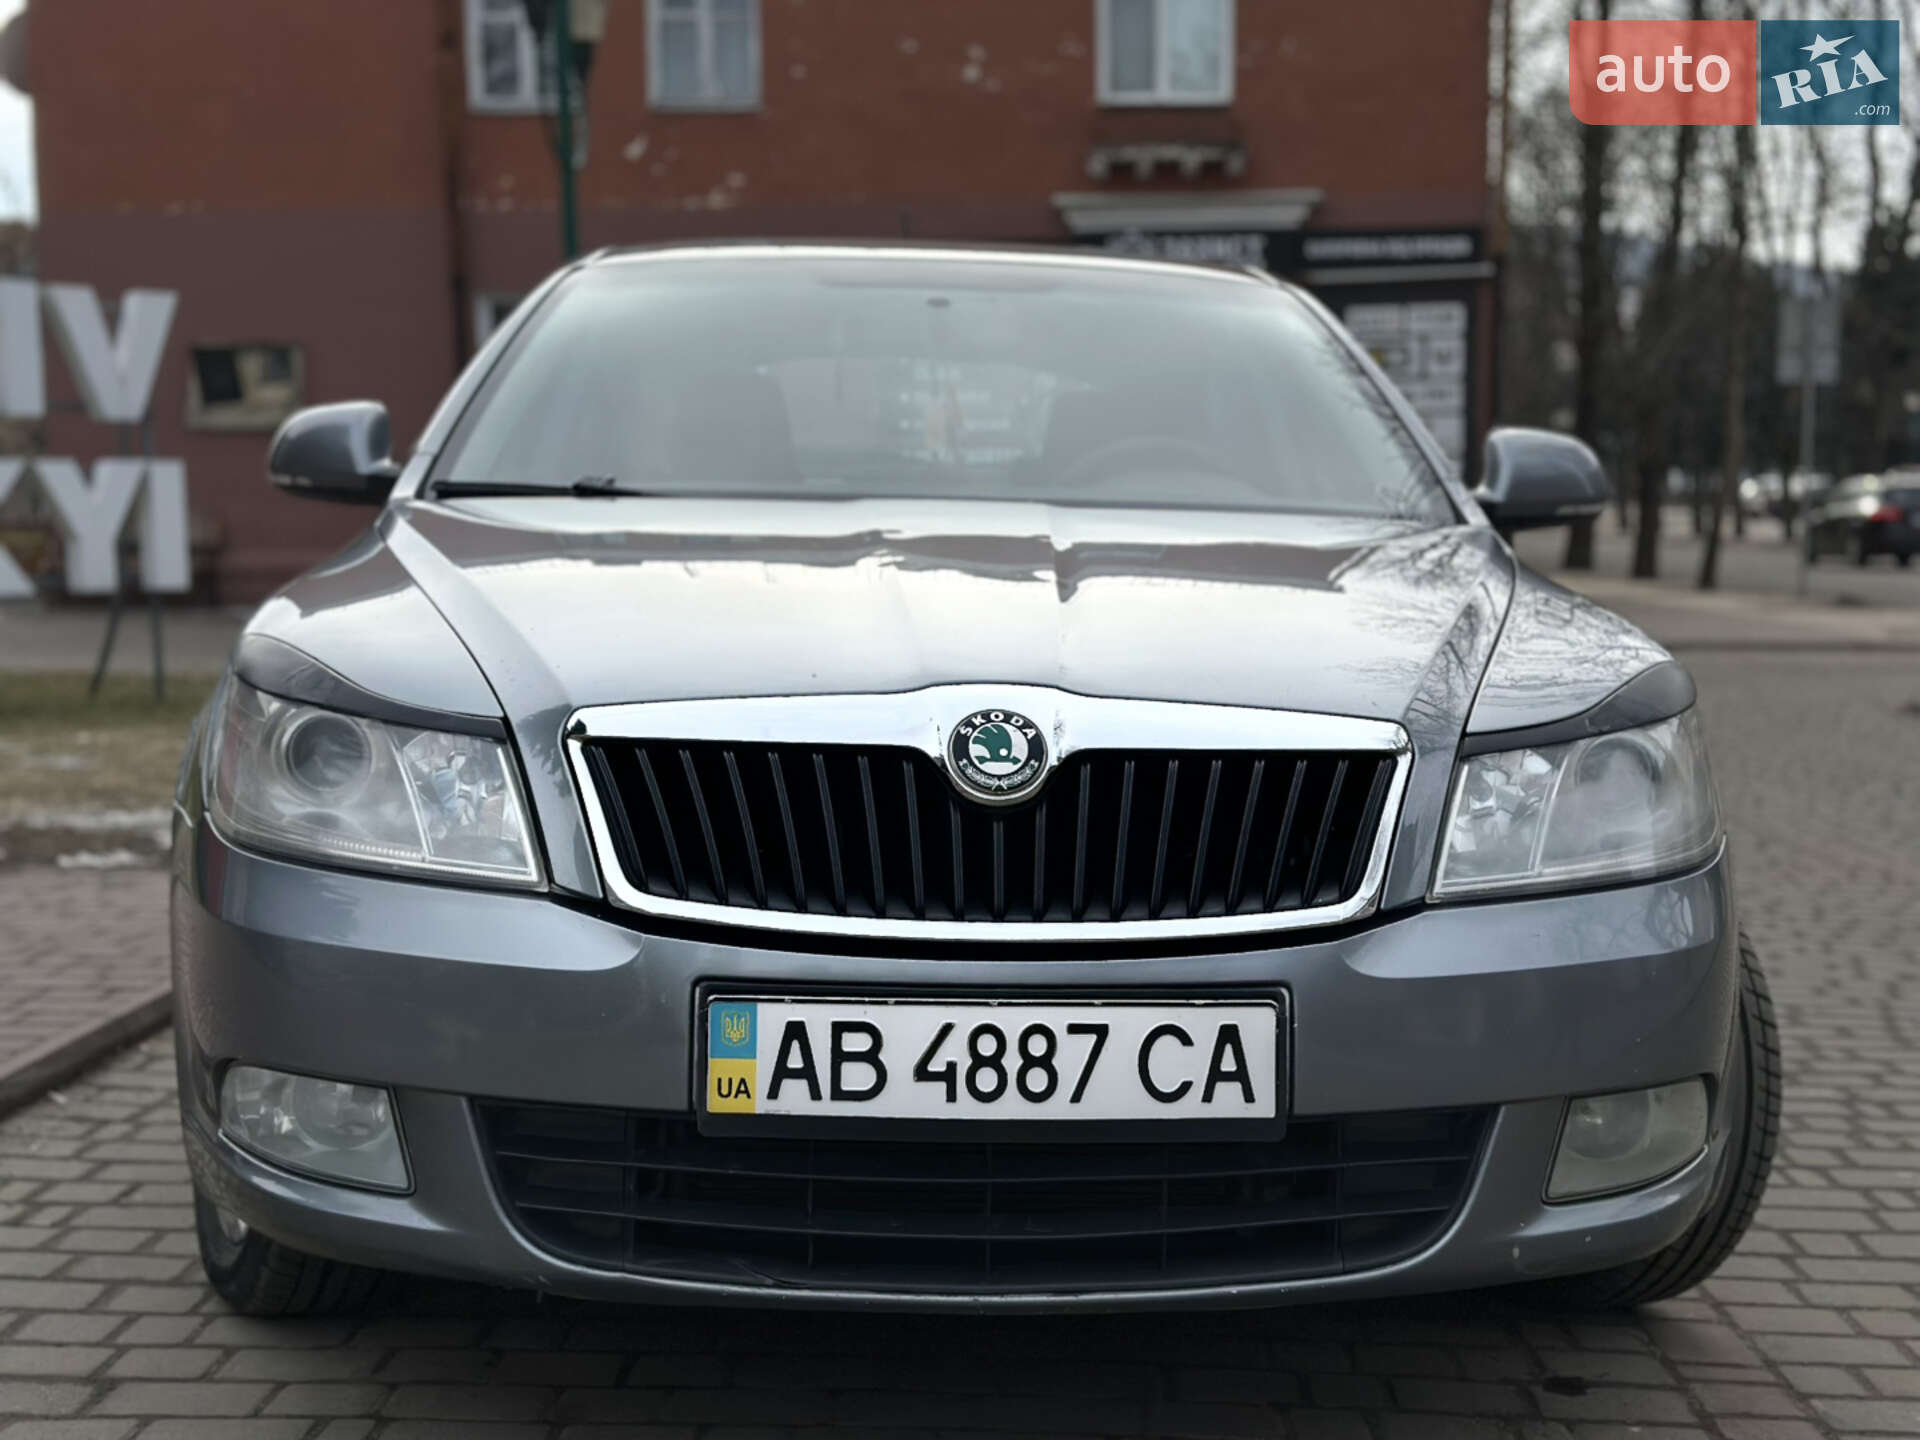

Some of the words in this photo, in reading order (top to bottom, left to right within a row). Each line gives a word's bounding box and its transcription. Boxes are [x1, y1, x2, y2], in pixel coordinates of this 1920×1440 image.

[717, 1077, 752, 1100] UA
[766, 1020, 888, 1102] AB
[913, 1022, 1109, 1104] 4887
[1138, 1022, 1256, 1104] CA
